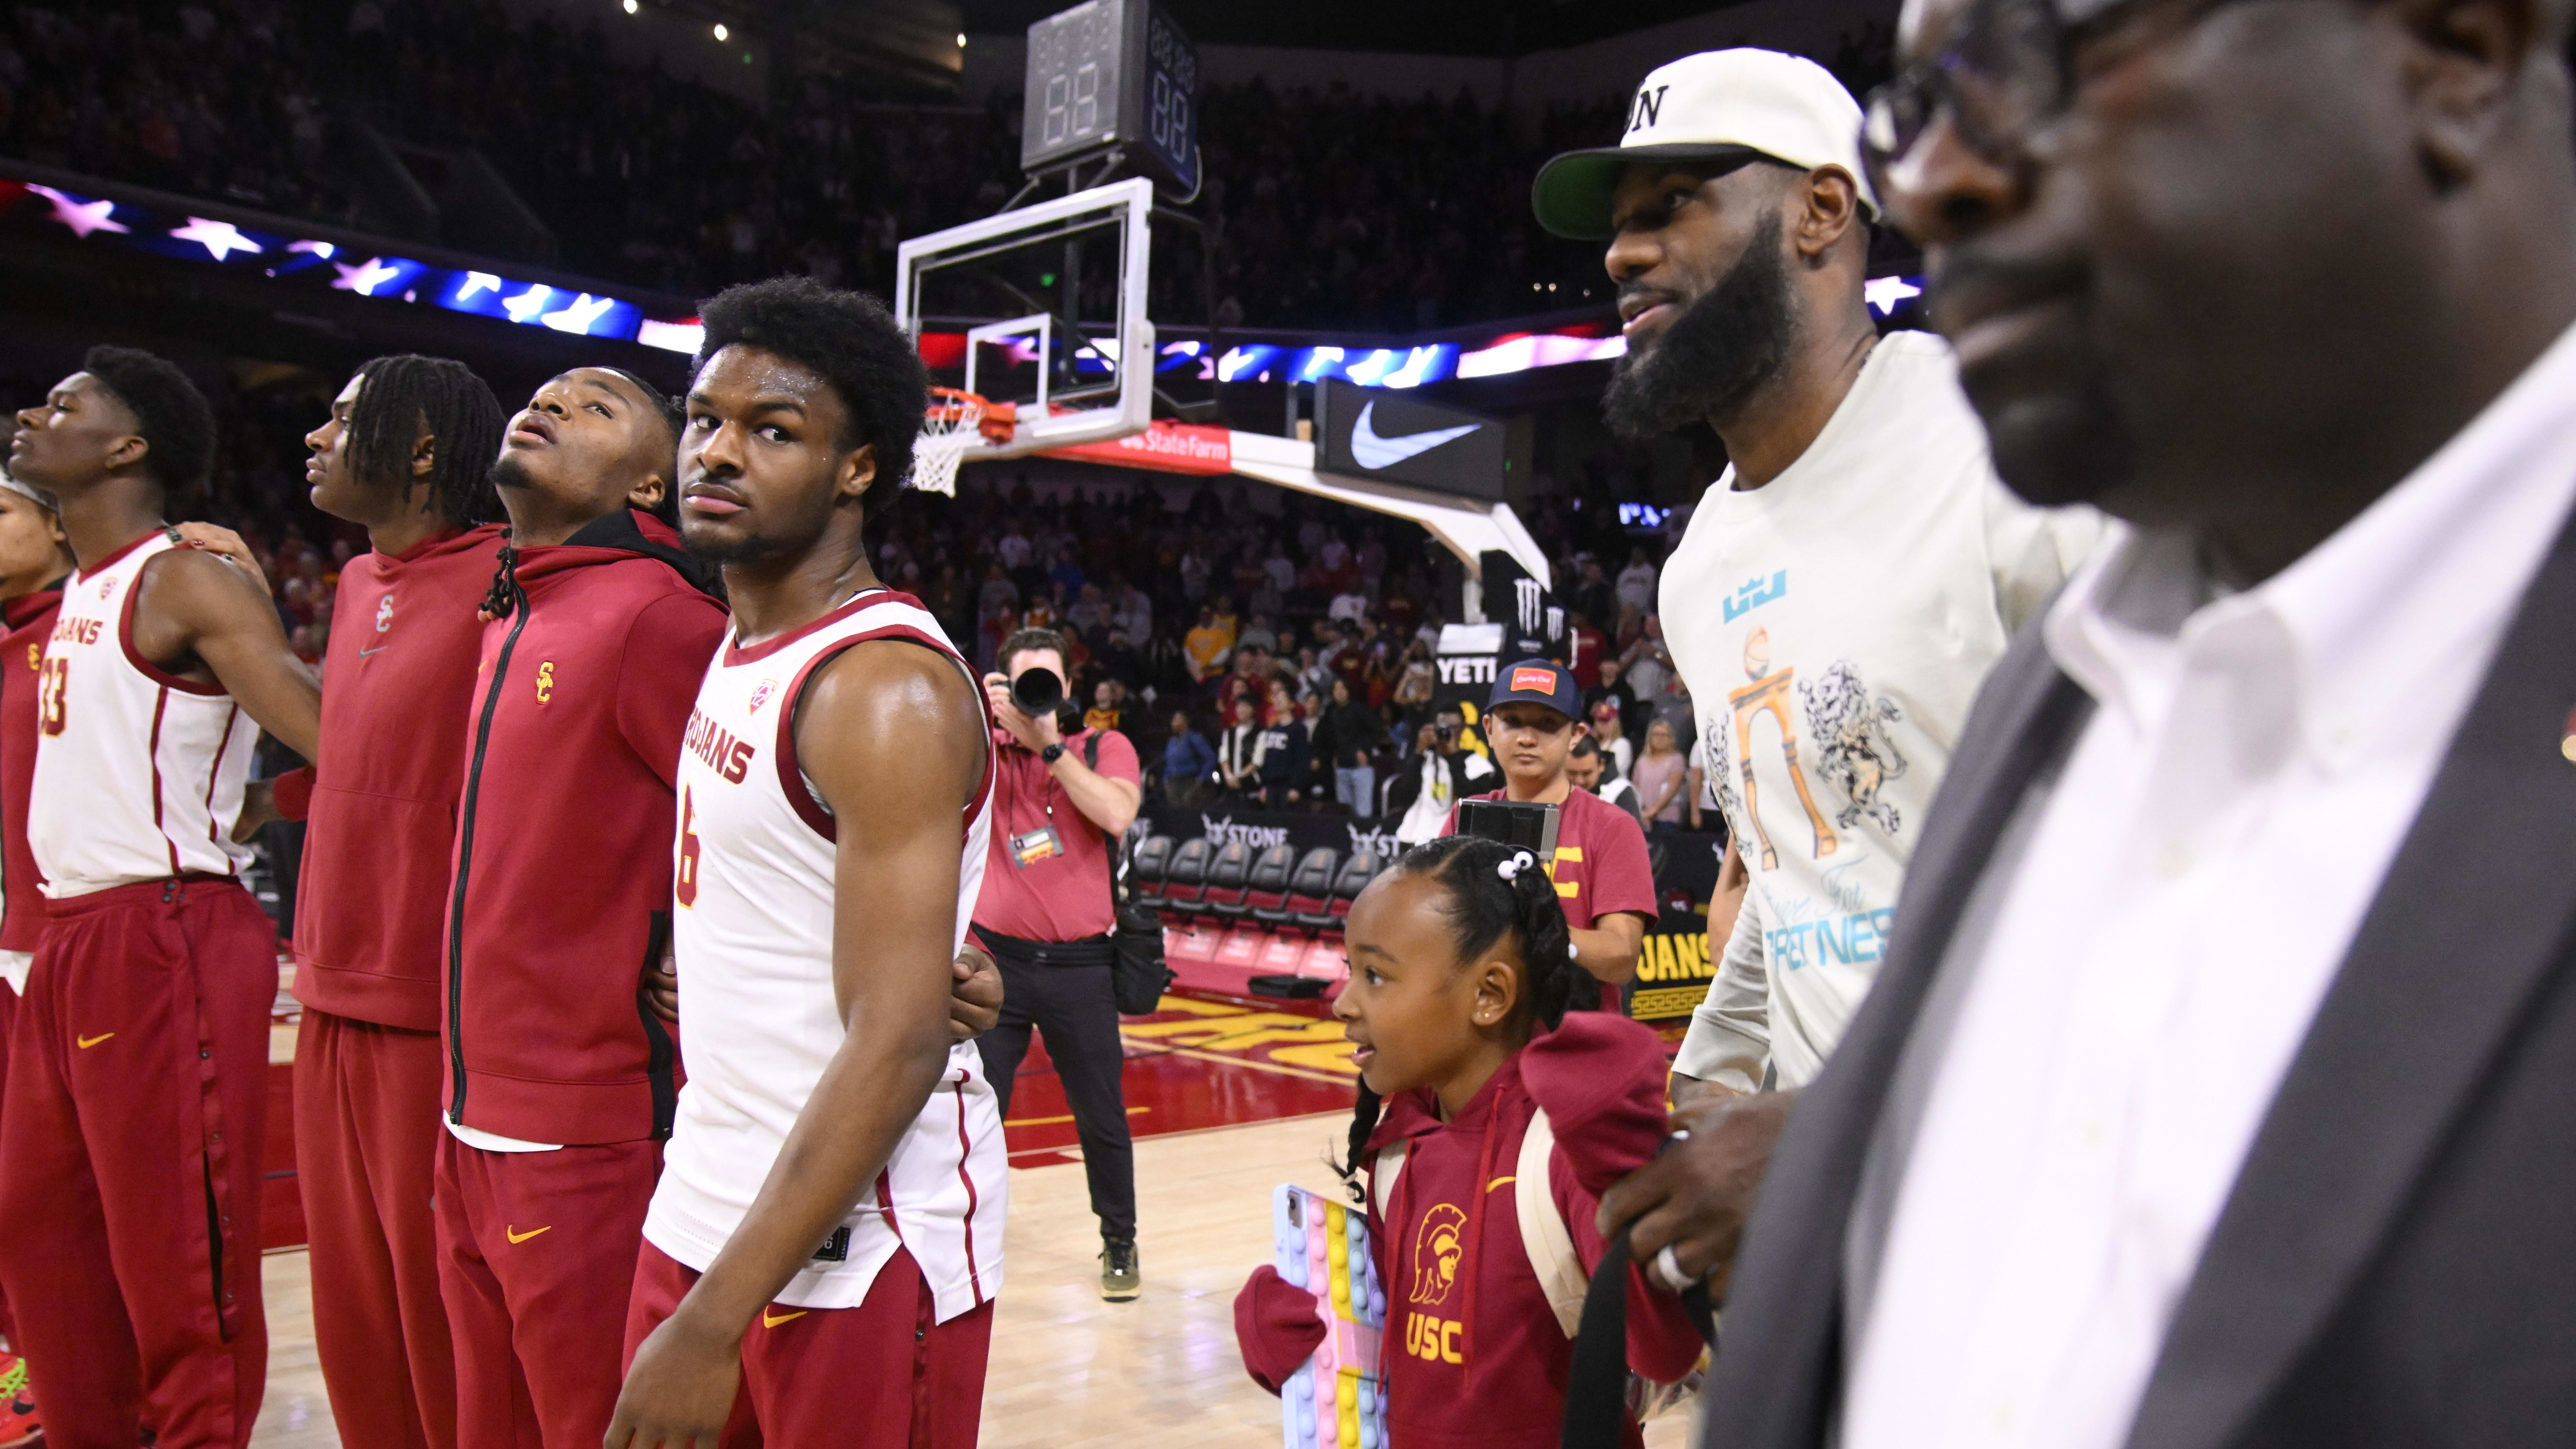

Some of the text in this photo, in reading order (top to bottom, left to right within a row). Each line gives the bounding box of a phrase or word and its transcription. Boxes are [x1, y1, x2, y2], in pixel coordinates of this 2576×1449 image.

[1436, 657, 1497, 684] YETI
[683, 705, 756, 784] ROJANS
[1636, 932, 1718, 982] JANS
[1406, 1312, 1462, 1364] USC
